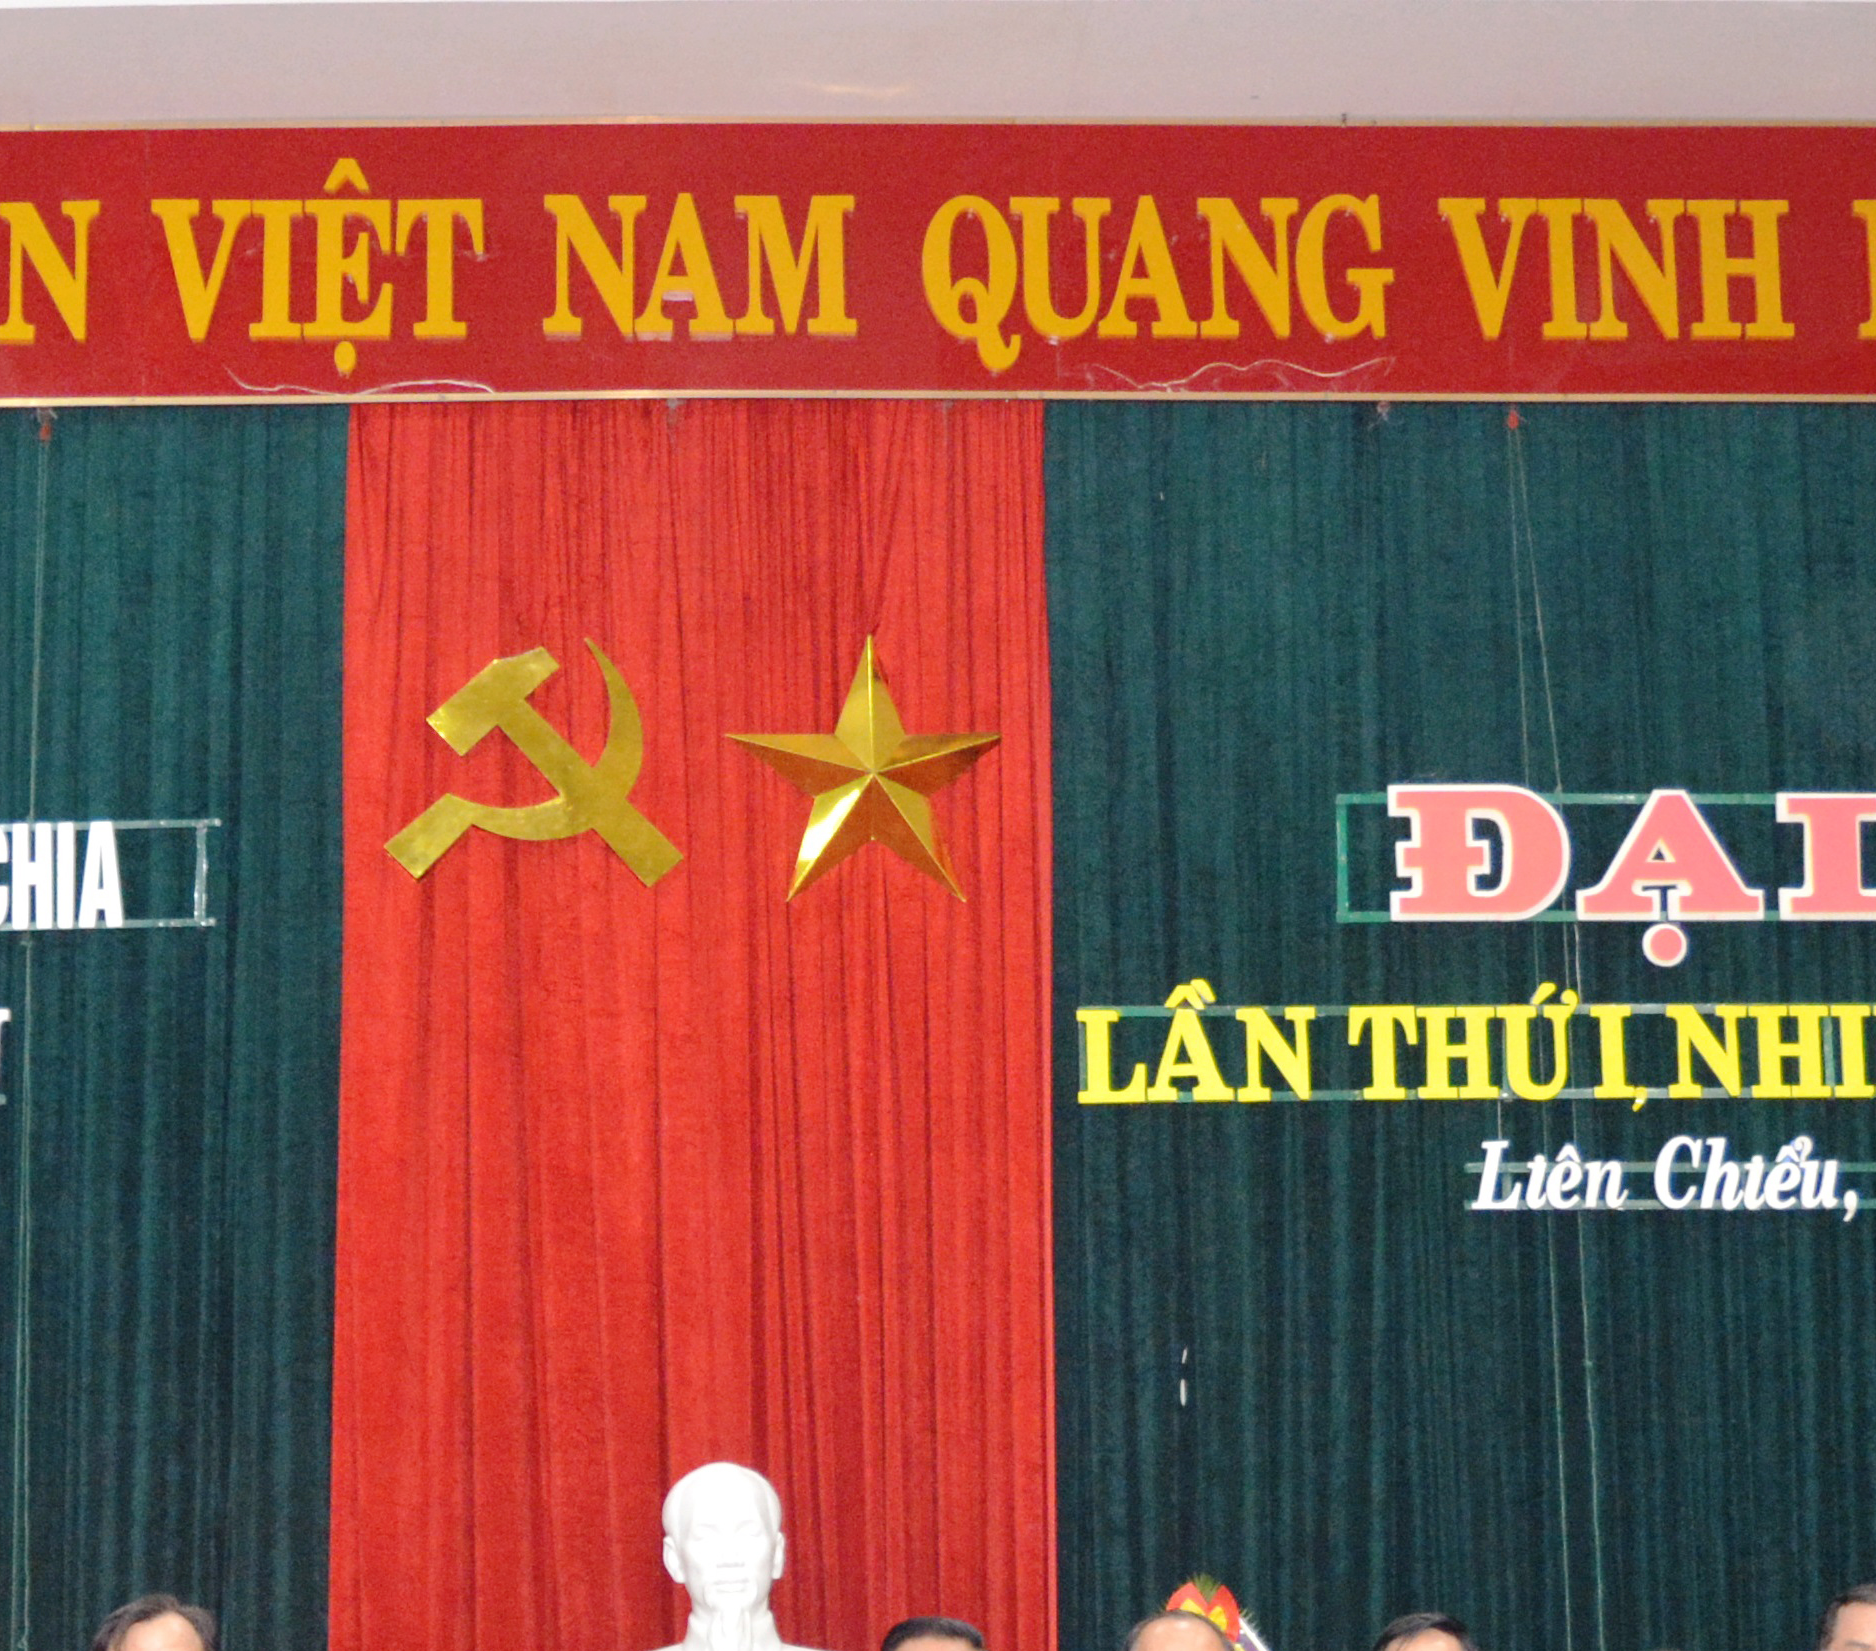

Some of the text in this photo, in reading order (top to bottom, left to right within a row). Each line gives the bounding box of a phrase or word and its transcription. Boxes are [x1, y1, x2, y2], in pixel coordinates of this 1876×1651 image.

[151, 157, 485, 375] VIỆT
[542, 192, 858, 342] NAM
[921, 193, 1395, 373] QUANG
[1438, 197, 1796, 343] VINH
[1076, 978, 1316, 1104] LẦN
[1347, 981, 1578, 1101] THỨ
[1470, 1139, 1629, 1211] Liên
[1654, 1135, 1858, 1222] Chiểu,
